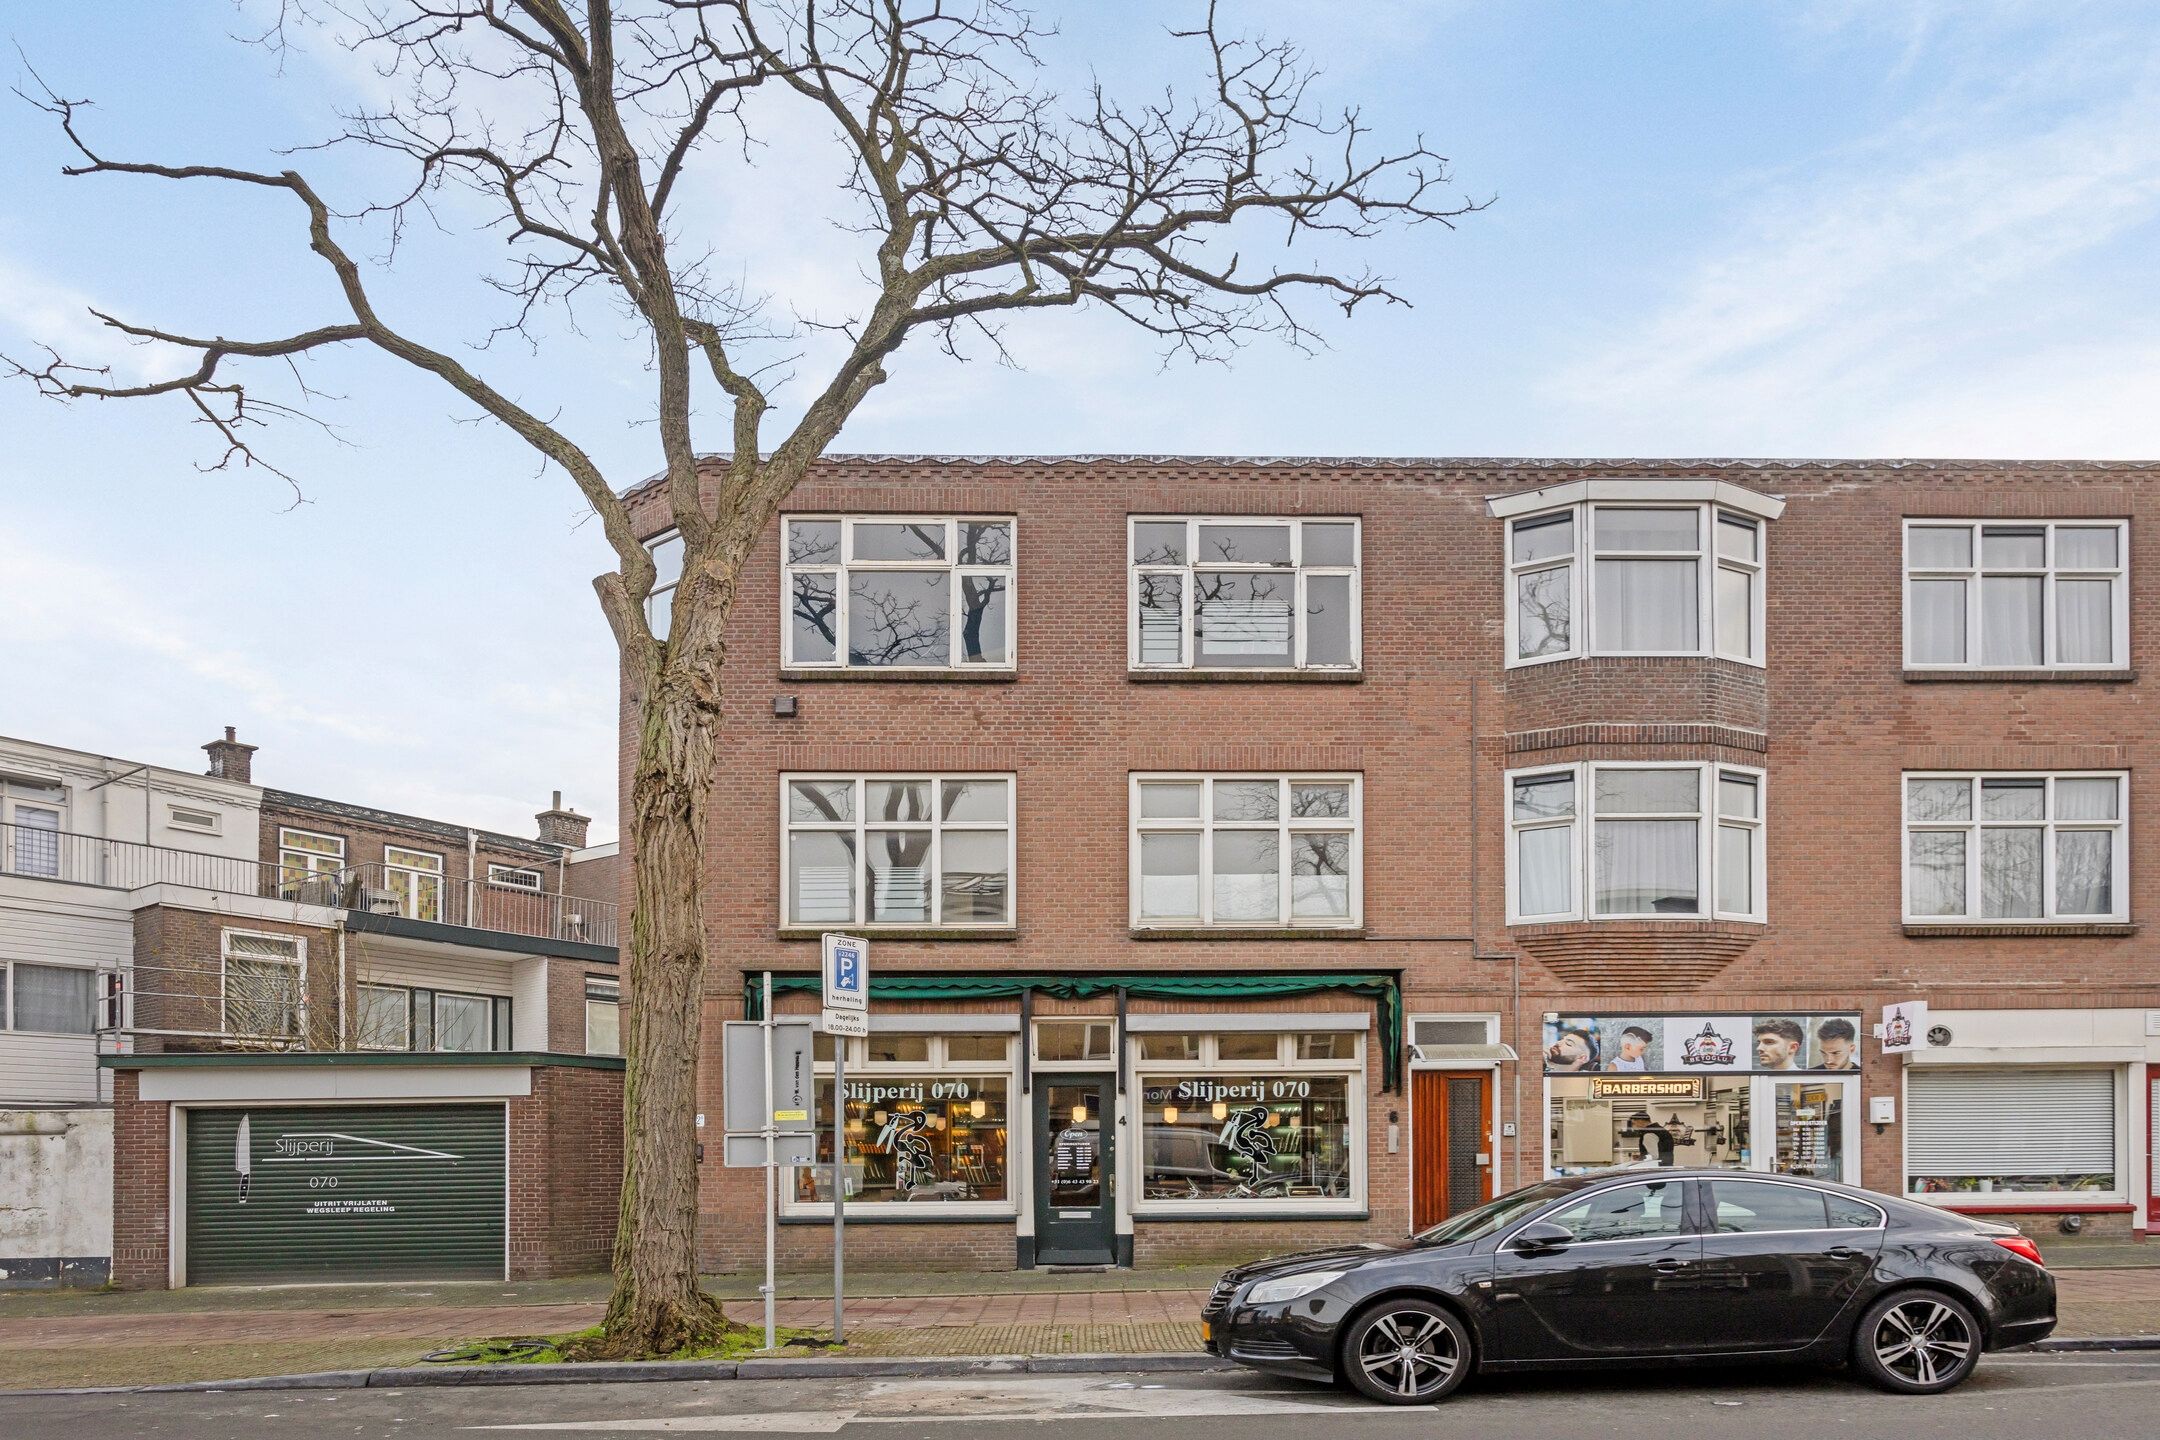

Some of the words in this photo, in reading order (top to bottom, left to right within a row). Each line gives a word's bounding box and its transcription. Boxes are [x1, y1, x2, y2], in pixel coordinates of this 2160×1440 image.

[840, 957, 853, 976] P
[832, 995, 862, 1004] herhaling
[835, 1013, 859, 1022] Dagelijks
[842, 1082, 924, 1103] Slijperij
[931, 1082, 969, 1099] 070
[1178, 1081, 1265, 1102] Slijperij
[1272, 1081, 1310, 1098] 070
[1603, 1083, 1692, 1094] BARBERSHOP
[1118, 1116, 1127, 1126] 4
[1064, 1130, 1083, 1138] Open
[275, 1138, 334, 1156] Slijperij
[309, 1177, 338, 1188] 070
